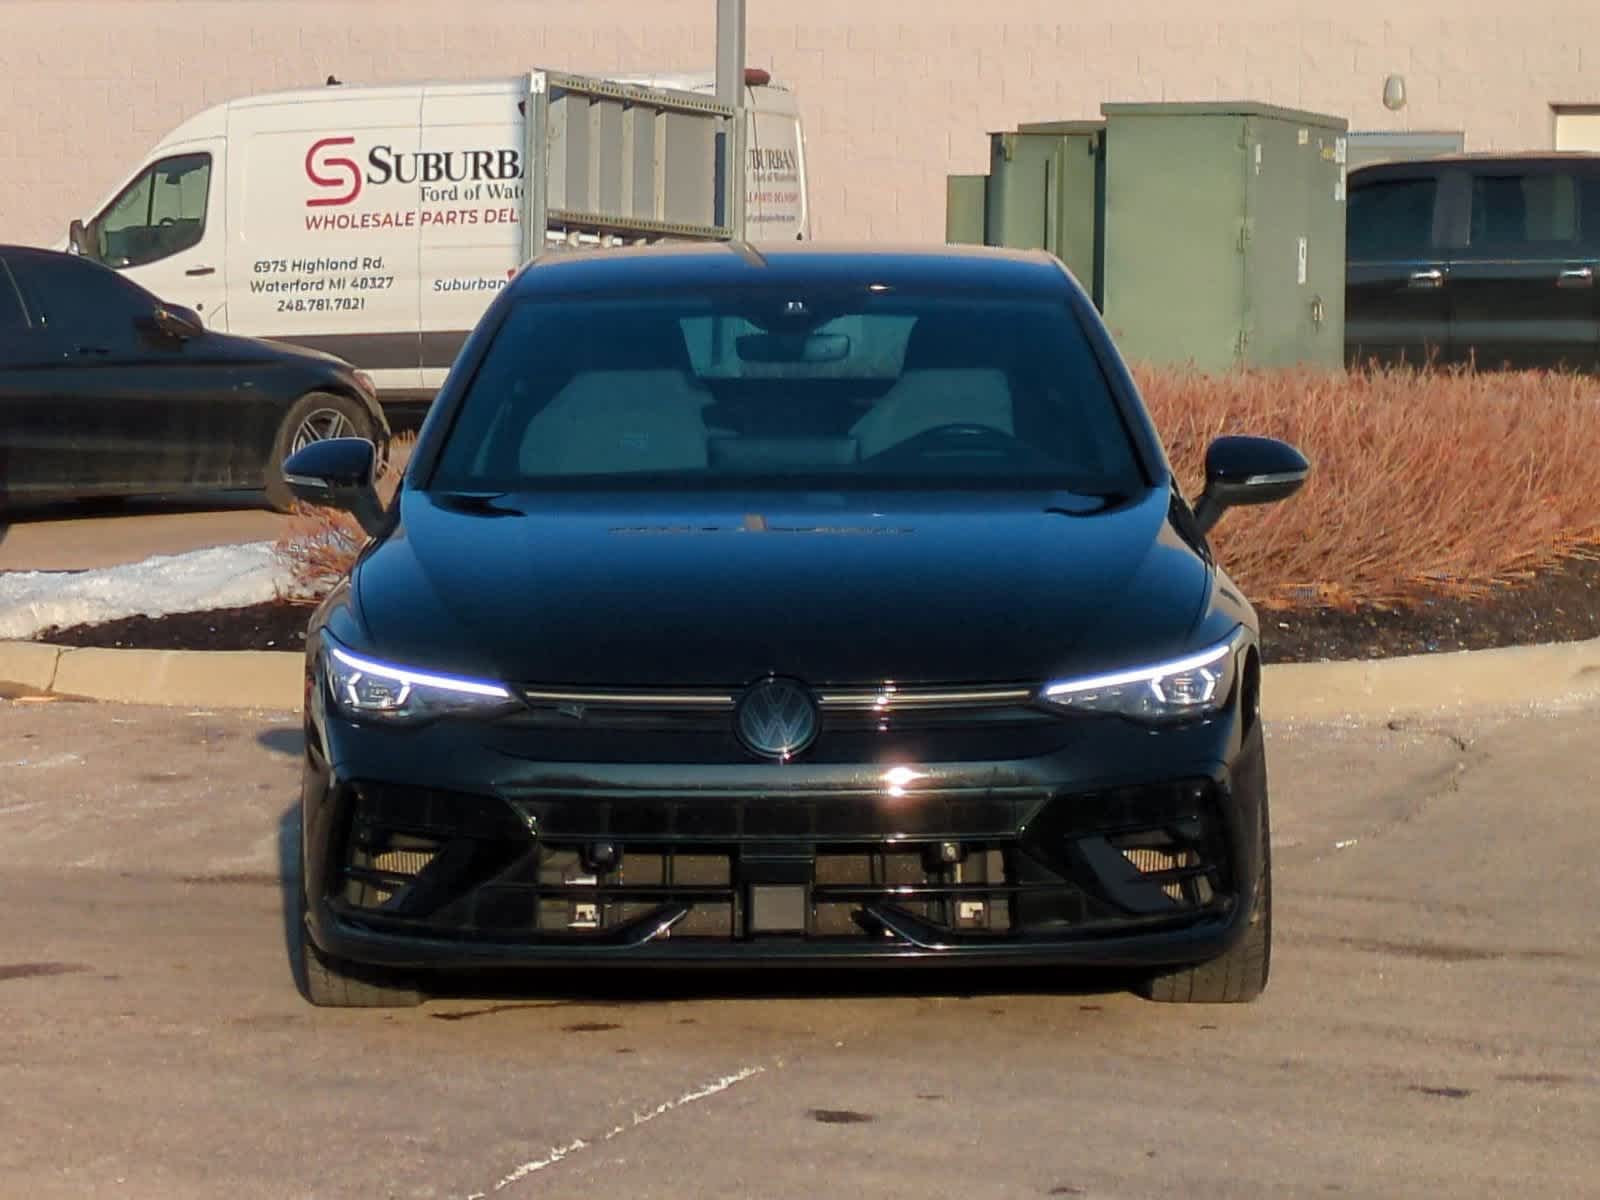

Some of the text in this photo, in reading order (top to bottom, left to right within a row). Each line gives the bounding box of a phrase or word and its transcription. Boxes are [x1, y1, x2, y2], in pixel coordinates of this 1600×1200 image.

[367, 145, 524, 185] SUBURB
[421, 186, 459, 202] Ford
[464, 184, 481, 201] of
[305, 211, 415, 231] WHOLESALE
[420, 209, 478, 226] PARTS
[253, 256, 385, 274] 6975 Highland Rd.
[249, 278, 324, 293] Waterford
[328, 278, 346, 291] MI
